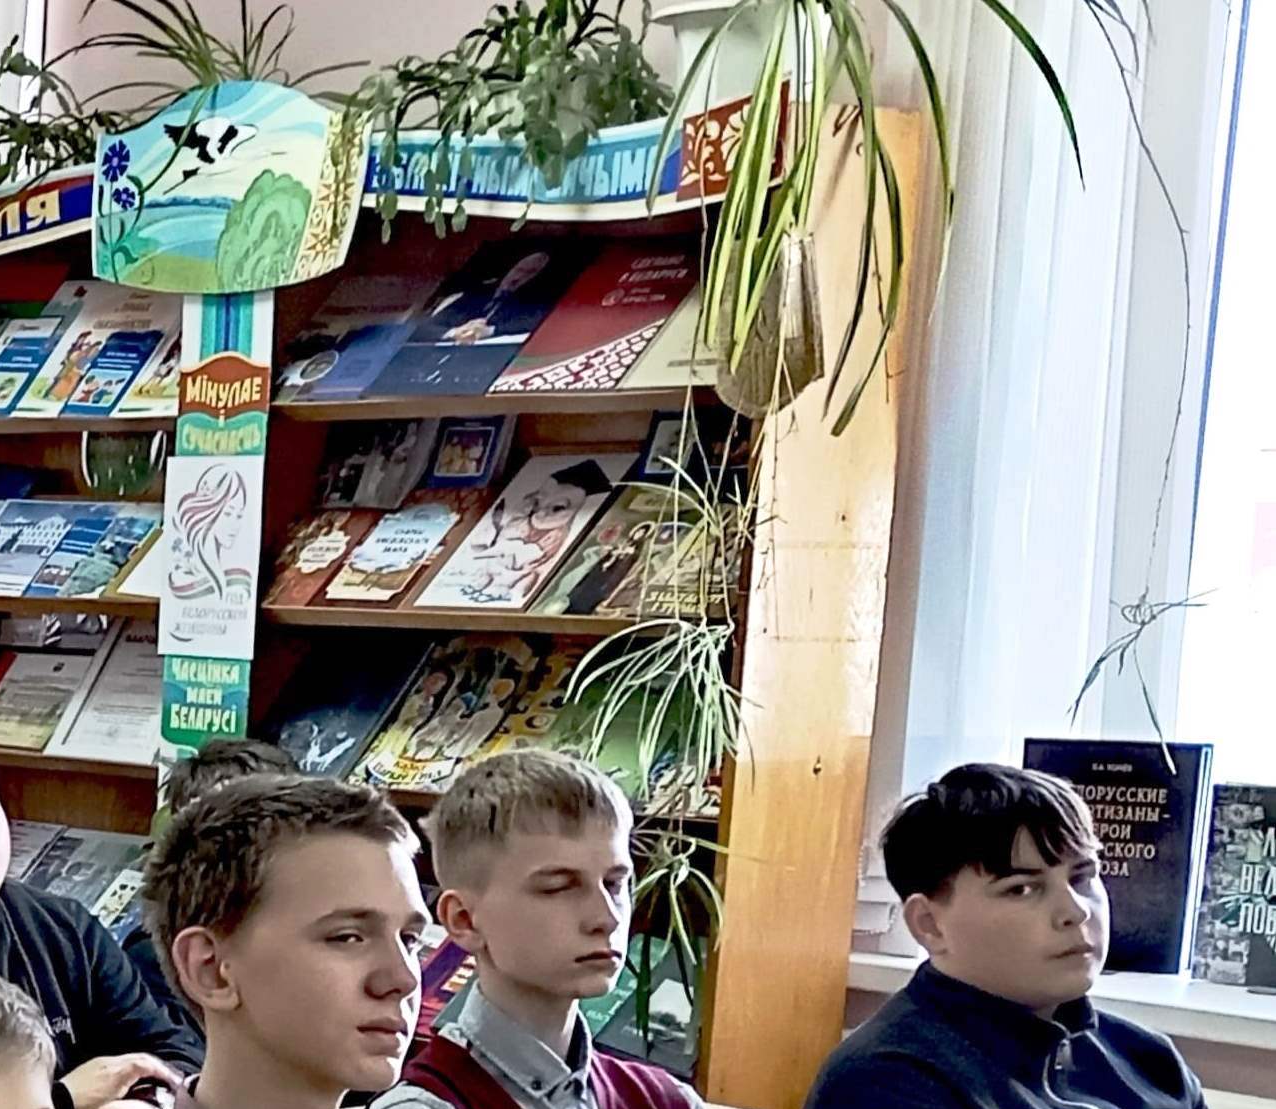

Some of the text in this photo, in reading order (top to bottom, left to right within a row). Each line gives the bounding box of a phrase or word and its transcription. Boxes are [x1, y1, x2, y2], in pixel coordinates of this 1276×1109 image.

[185, 375, 262, 409] МІНУЛАЕ
[170, 703, 236, 733] БЕЛАРУСІ
[1104, 842, 1156, 859] СКОГО
[1238, 902, 1276, 935] ПОБ
